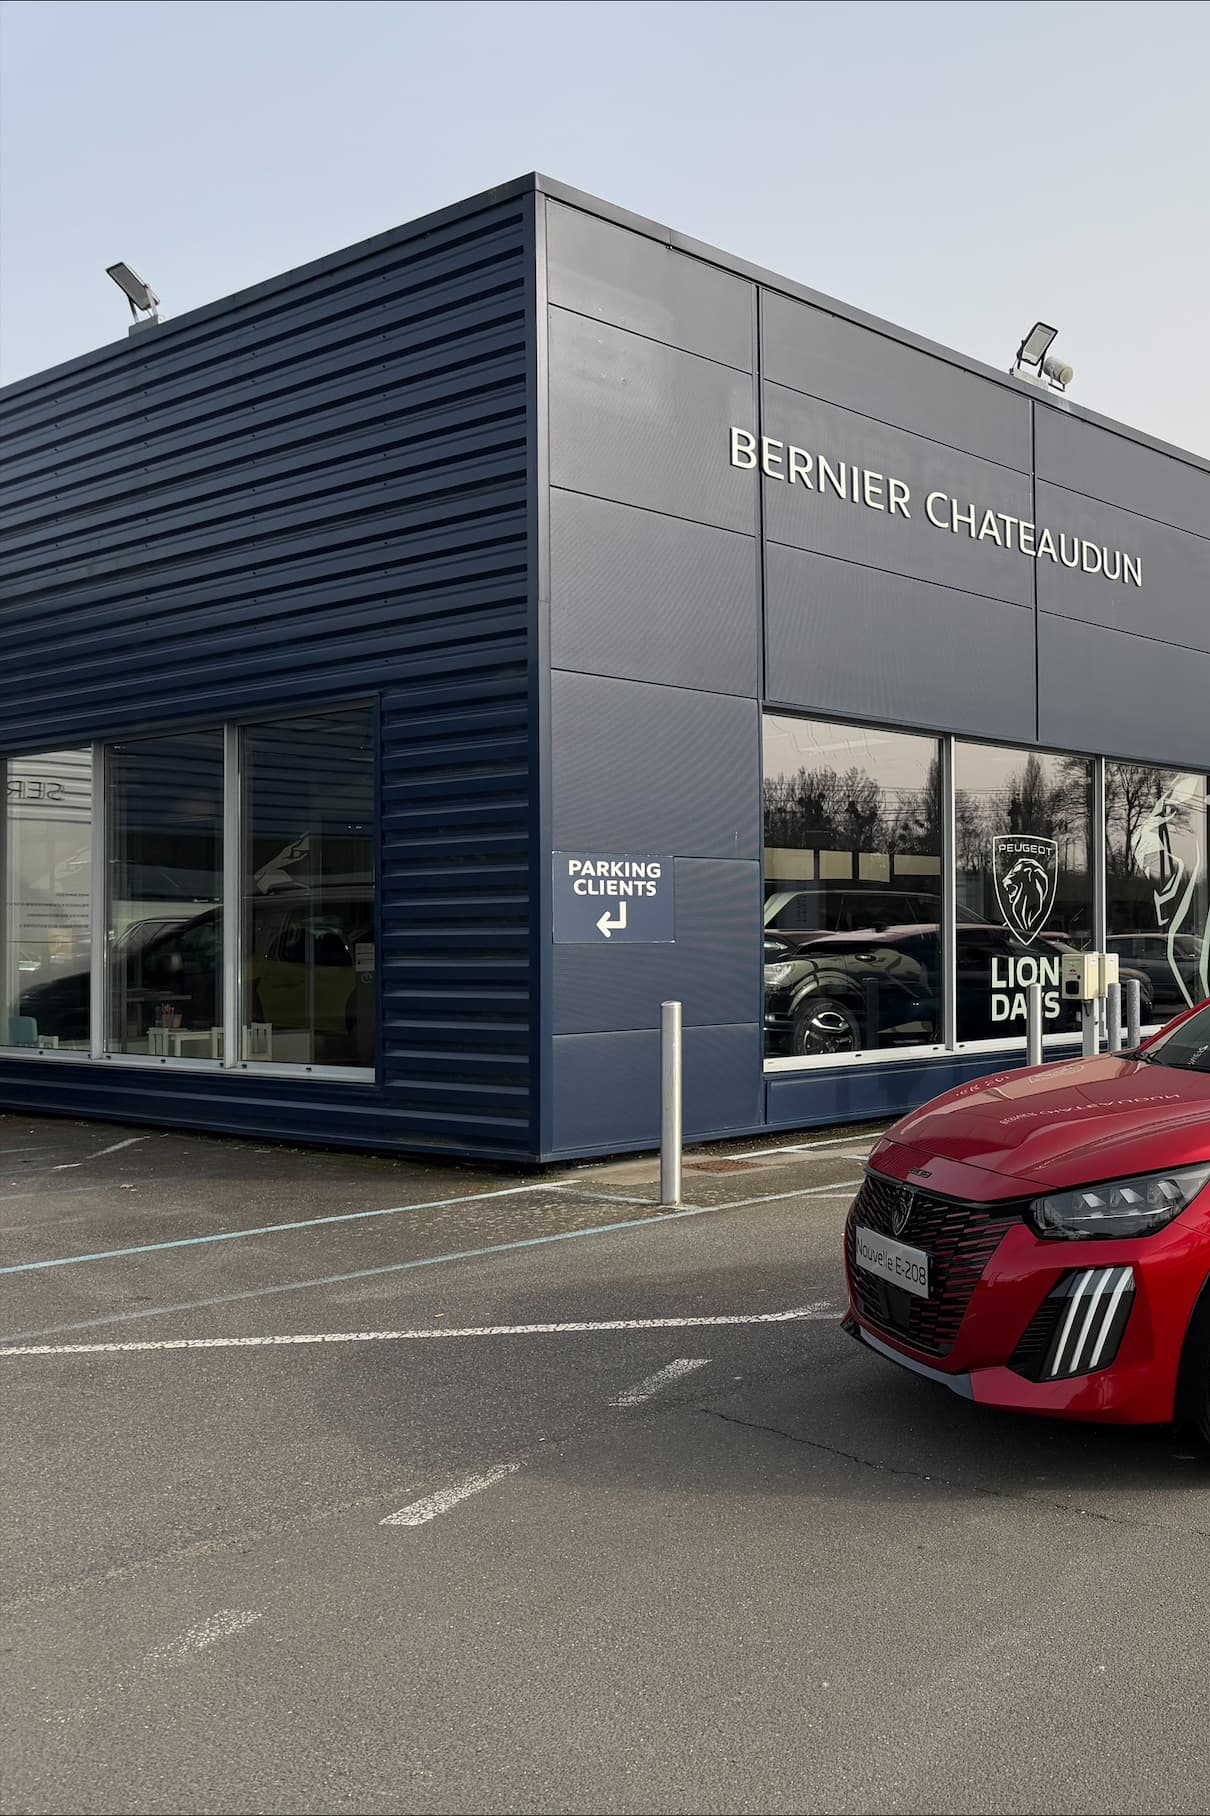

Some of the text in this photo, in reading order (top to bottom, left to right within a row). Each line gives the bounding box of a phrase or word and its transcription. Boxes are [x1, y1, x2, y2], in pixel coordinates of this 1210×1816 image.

[730, 426, 1143, 587] BERNIER CHATEAUDUN
[998, 843, 1053, 856] PEUGEOT
[568, 859, 661, 878] PARKING
[573, 878, 657, 897] CLIENTS
[991, 955, 1060, 988] LION
[991, 991, 1061, 1022] DAS
[856, 1236, 927, 1286] Nouvelle E-208
